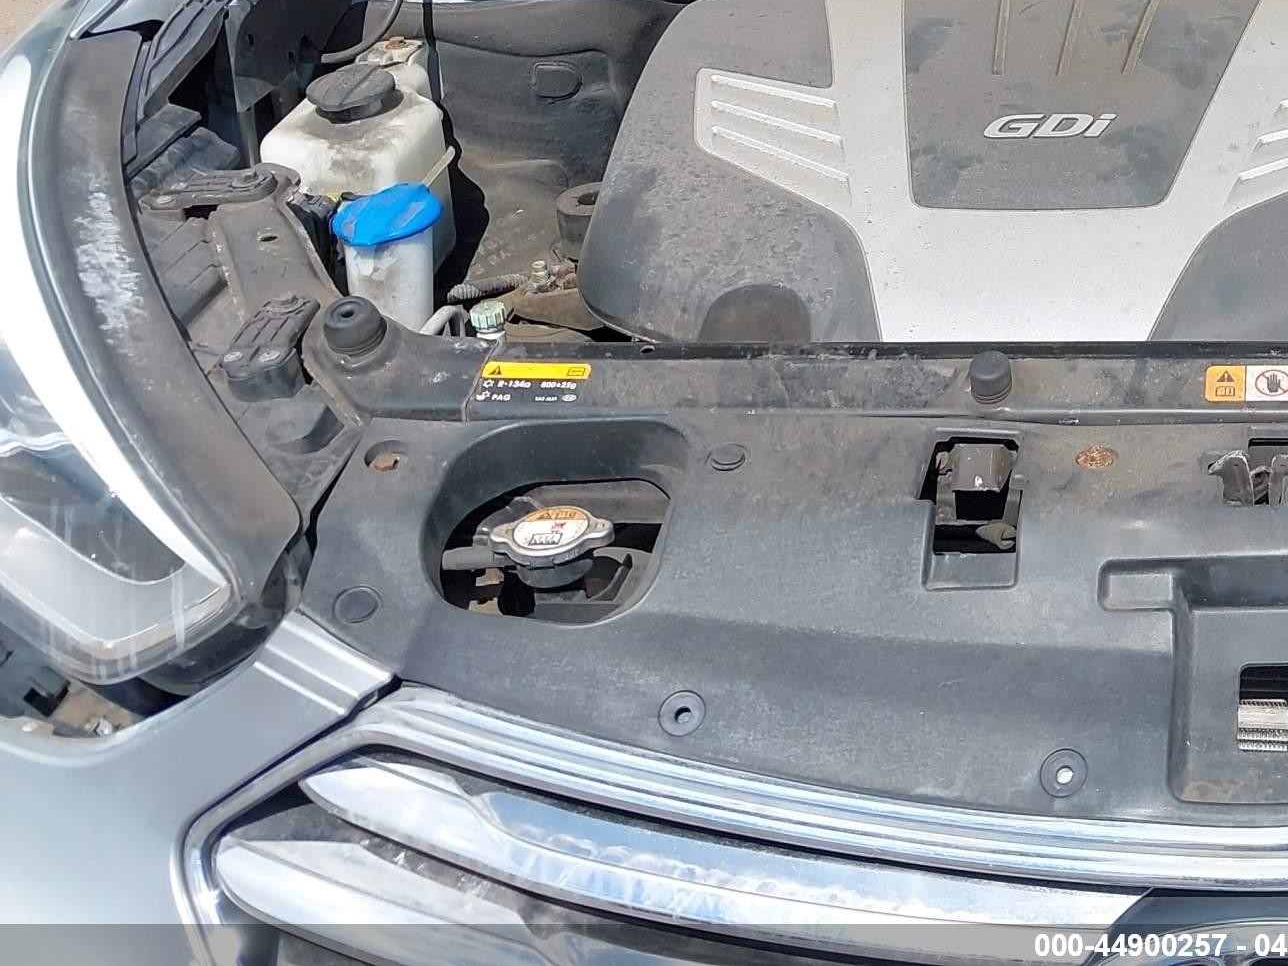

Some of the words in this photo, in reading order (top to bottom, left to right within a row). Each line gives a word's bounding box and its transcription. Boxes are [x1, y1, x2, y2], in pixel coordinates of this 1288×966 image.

[983, 113, 1119, 139] GDi
[497, 379, 532, 388] R-134a
[491, 393, 511, 401] PAG
